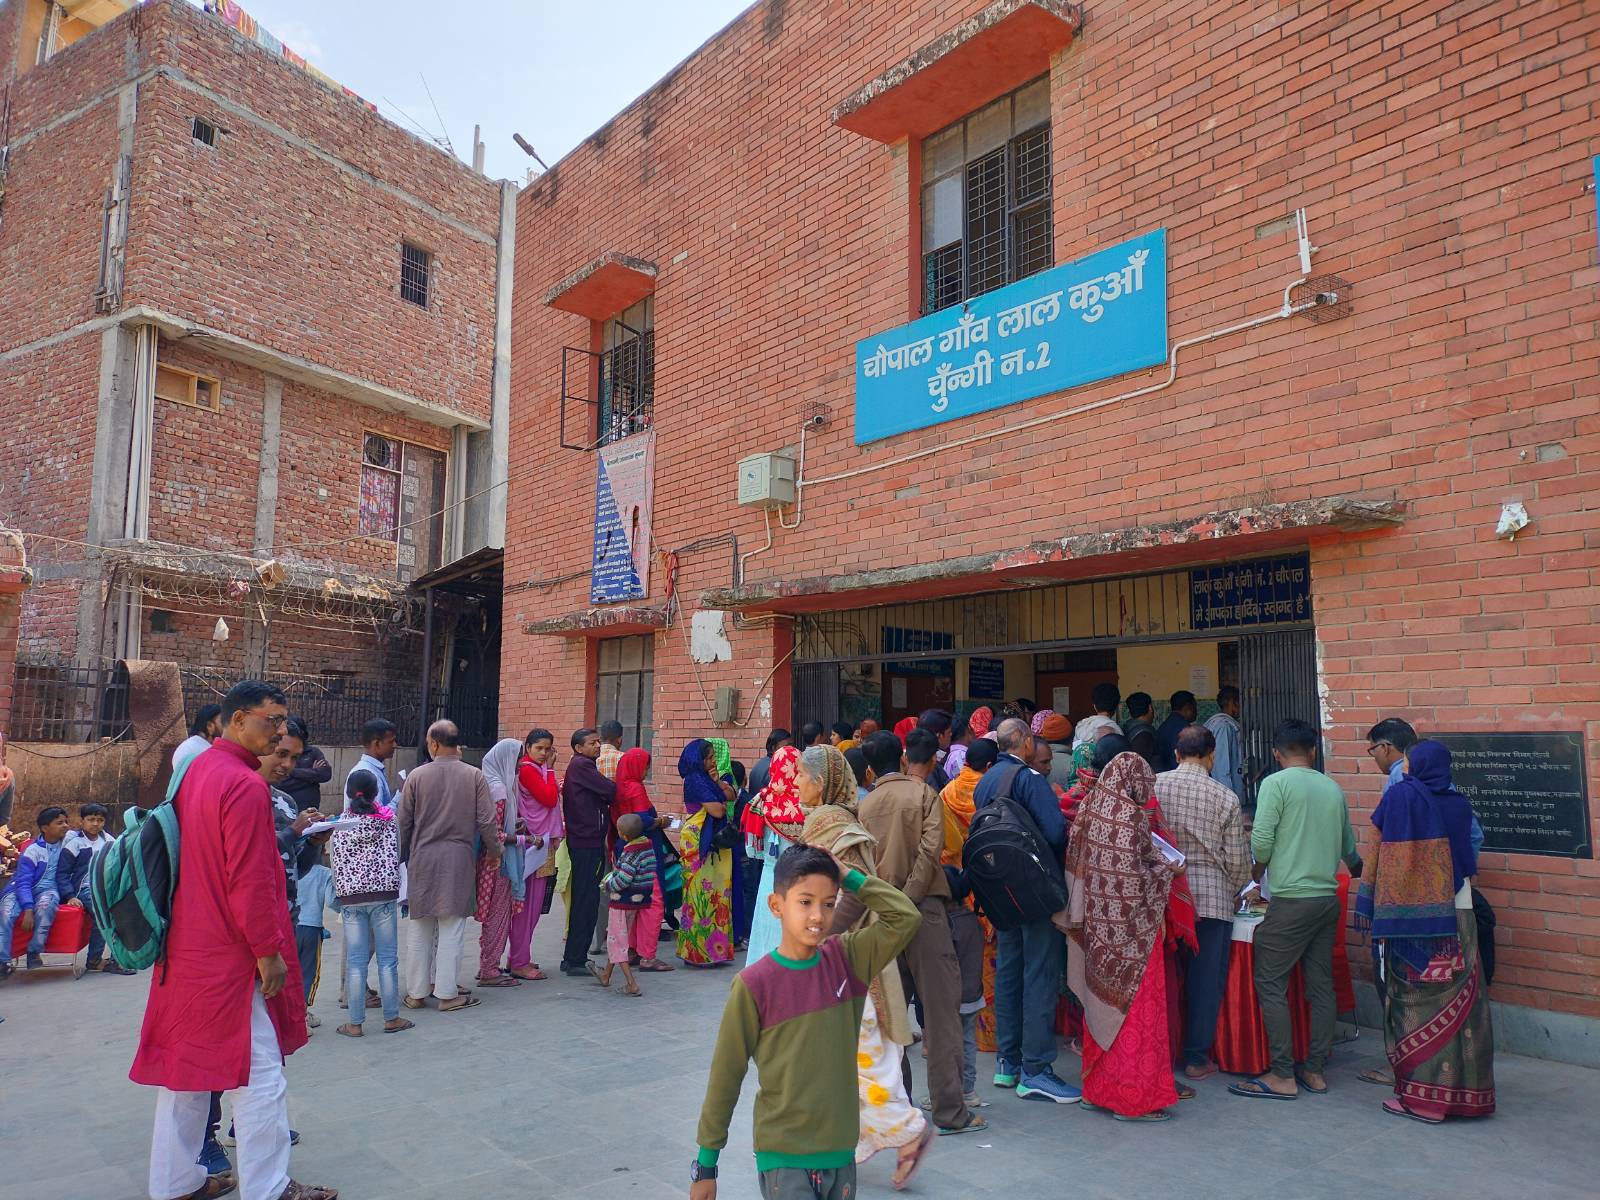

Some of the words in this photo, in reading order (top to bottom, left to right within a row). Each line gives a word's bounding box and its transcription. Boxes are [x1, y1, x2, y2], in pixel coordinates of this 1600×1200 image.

[863, 334, 936, 378] चौपाल
[938, 313, 992, 354] गाँव
[997, 290, 1063, 338] लाल
[1067, 248, 1150, 323] कुआँ
[1194, 579, 1212, 595] लाल
[1204, 606, 1233, 622] आपका
[1234, 597, 1262, 620] हार्दिक
[1264, 600, 1295, 616] स्वागत
